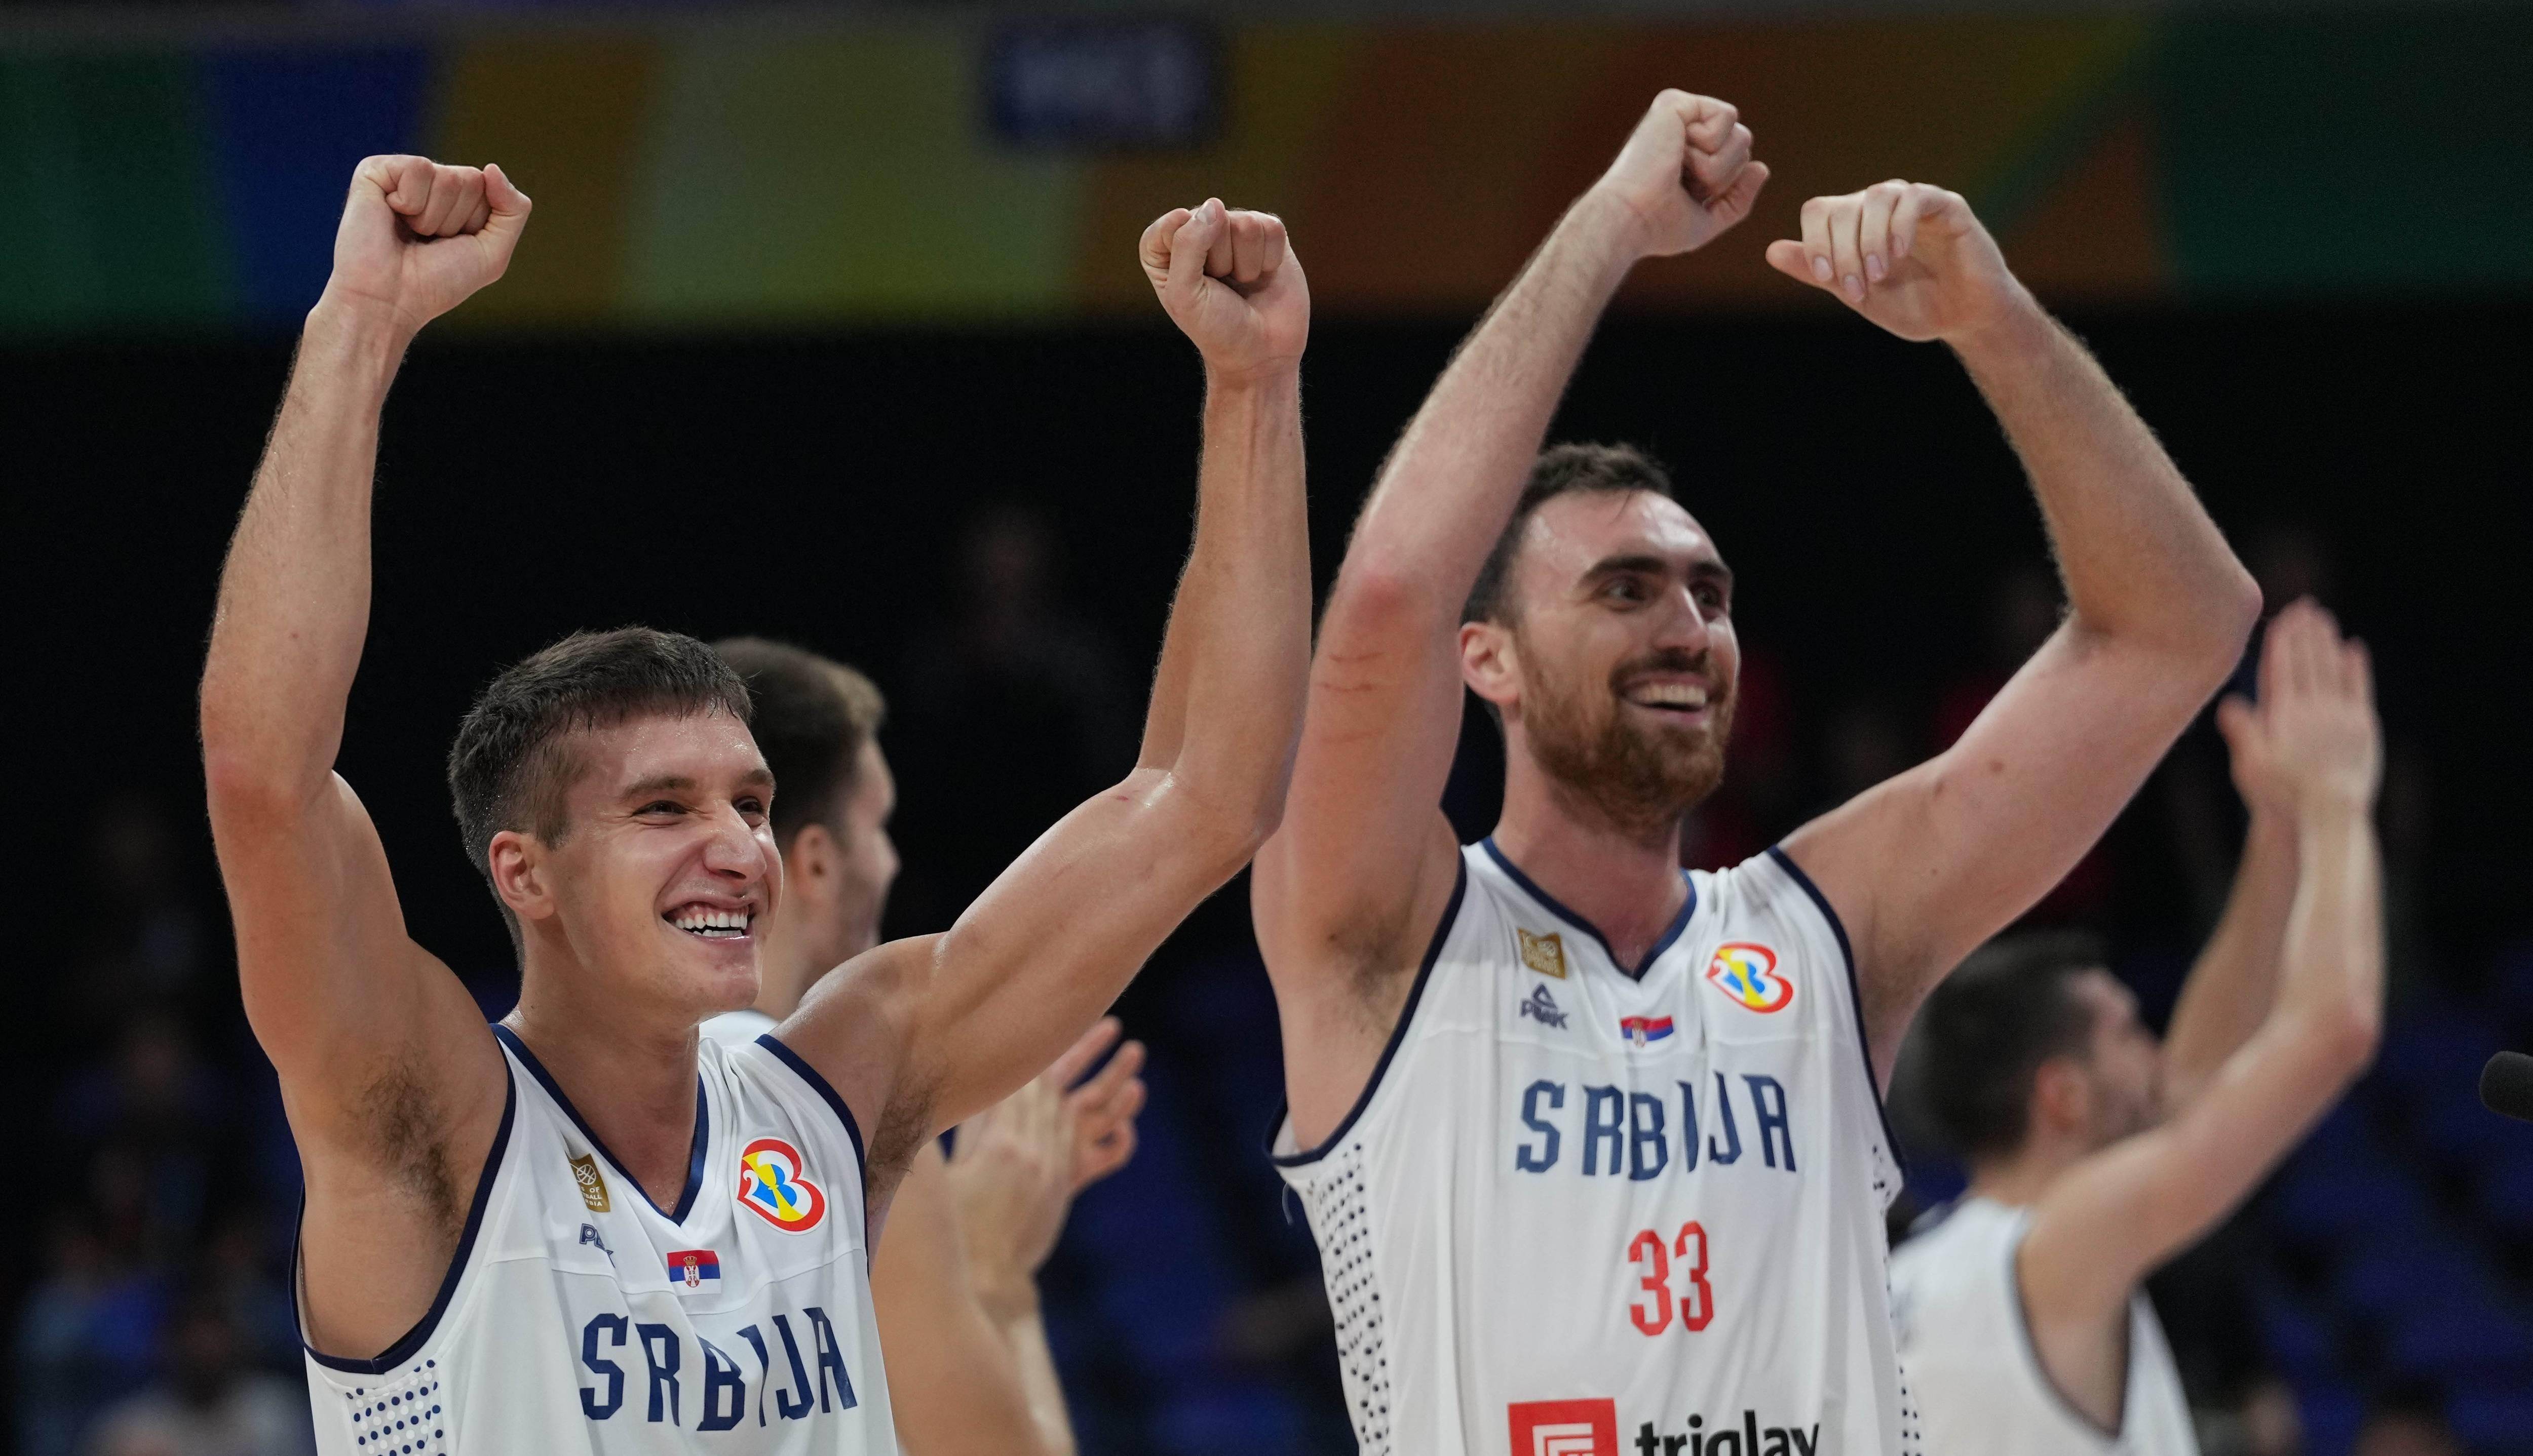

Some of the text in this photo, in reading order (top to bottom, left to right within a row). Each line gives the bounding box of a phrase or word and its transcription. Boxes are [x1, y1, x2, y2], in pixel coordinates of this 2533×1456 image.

[1515, 1070, 1796, 1180] SRBIJA
[1628, 1220, 1714, 1336] 33
[580, 1307, 857, 1431] SRBIJA
